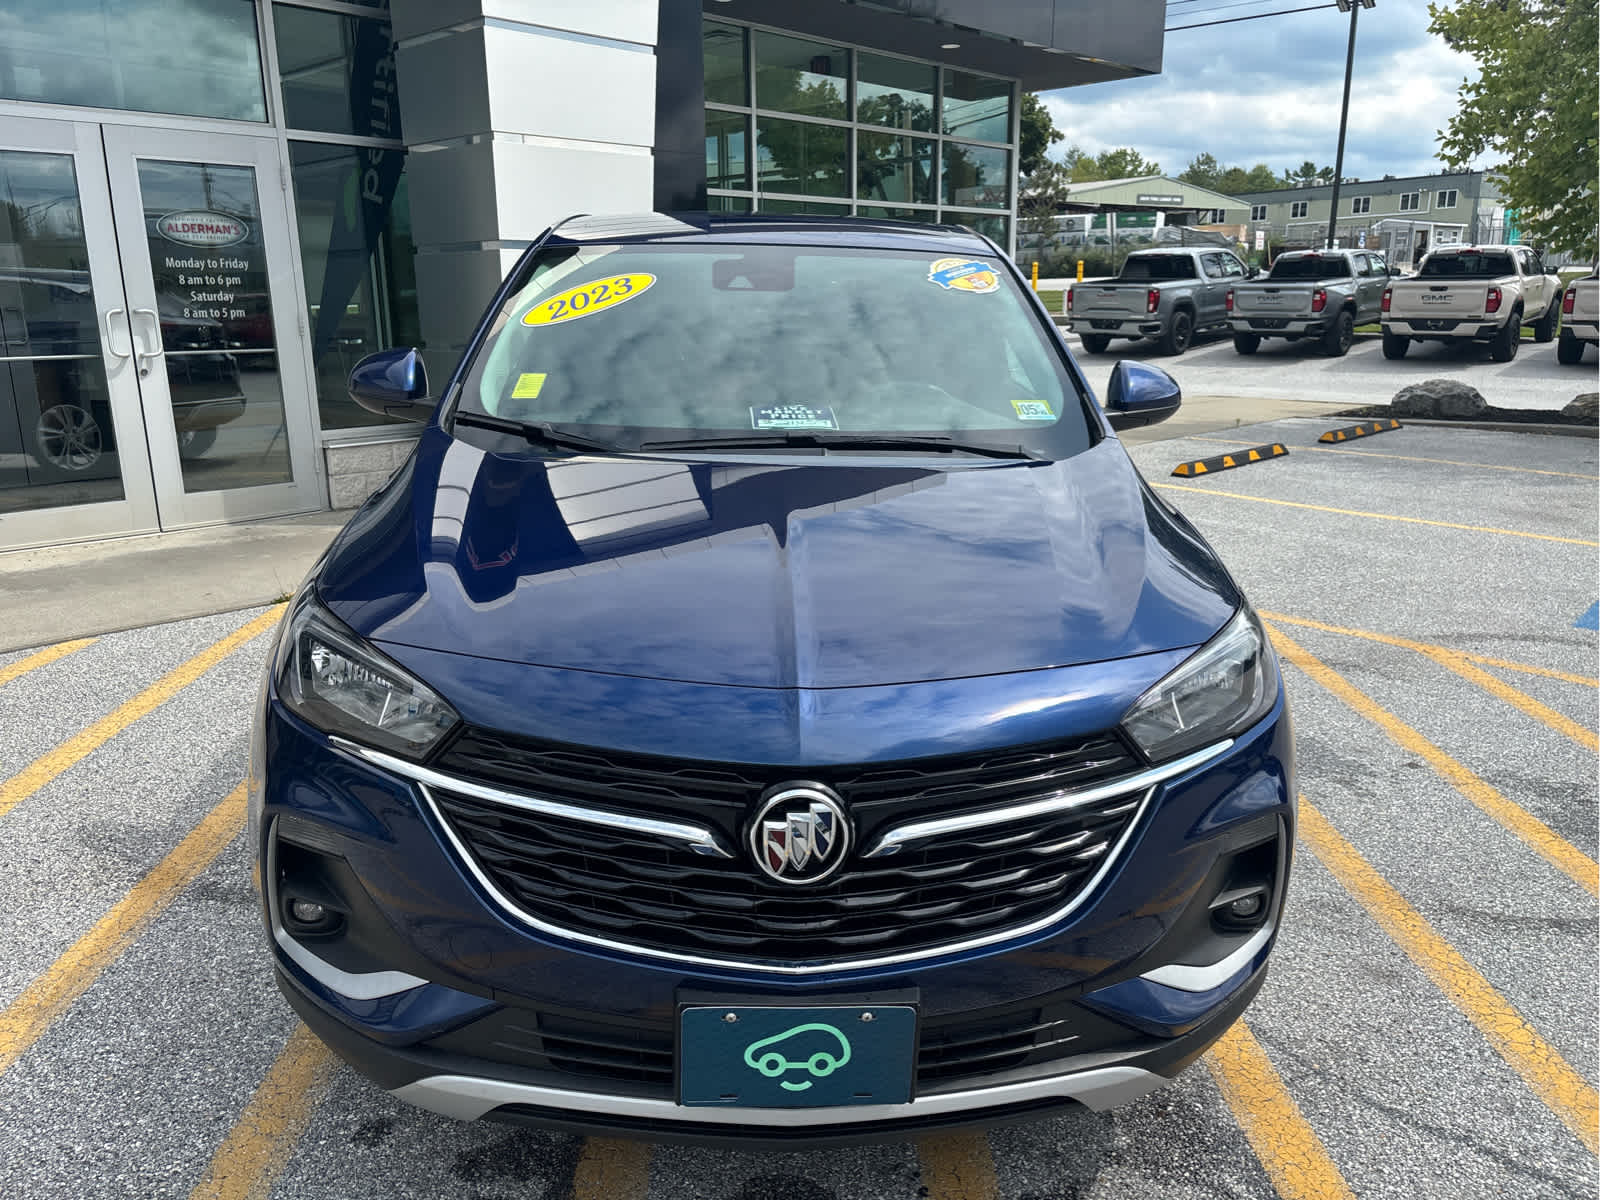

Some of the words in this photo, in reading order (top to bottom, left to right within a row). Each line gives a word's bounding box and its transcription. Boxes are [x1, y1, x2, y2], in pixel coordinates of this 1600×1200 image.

[167, 223, 241, 236] ALDERMAN'S
[165, 257, 205, 271] Monday
[207, 258, 218, 268] to
[220, 258, 249, 271] Friday
[178, 274, 186, 285] 8
[187, 277, 203, 285] am
[204, 275, 216, 285] to
[217, 275, 224, 285] 6
[226, 277, 241, 287] pm
[190, 290, 234, 303] Saturday
[548, 277, 633, 320] 2023
[1421, 294, 1454, 302] GMC
[183, 307, 190, 318] 8
[192, 310, 208, 318] am
[209, 308, 220, 318] to
[222, 308, 228, 318] 5
[230, 310, 246, 320] pm
